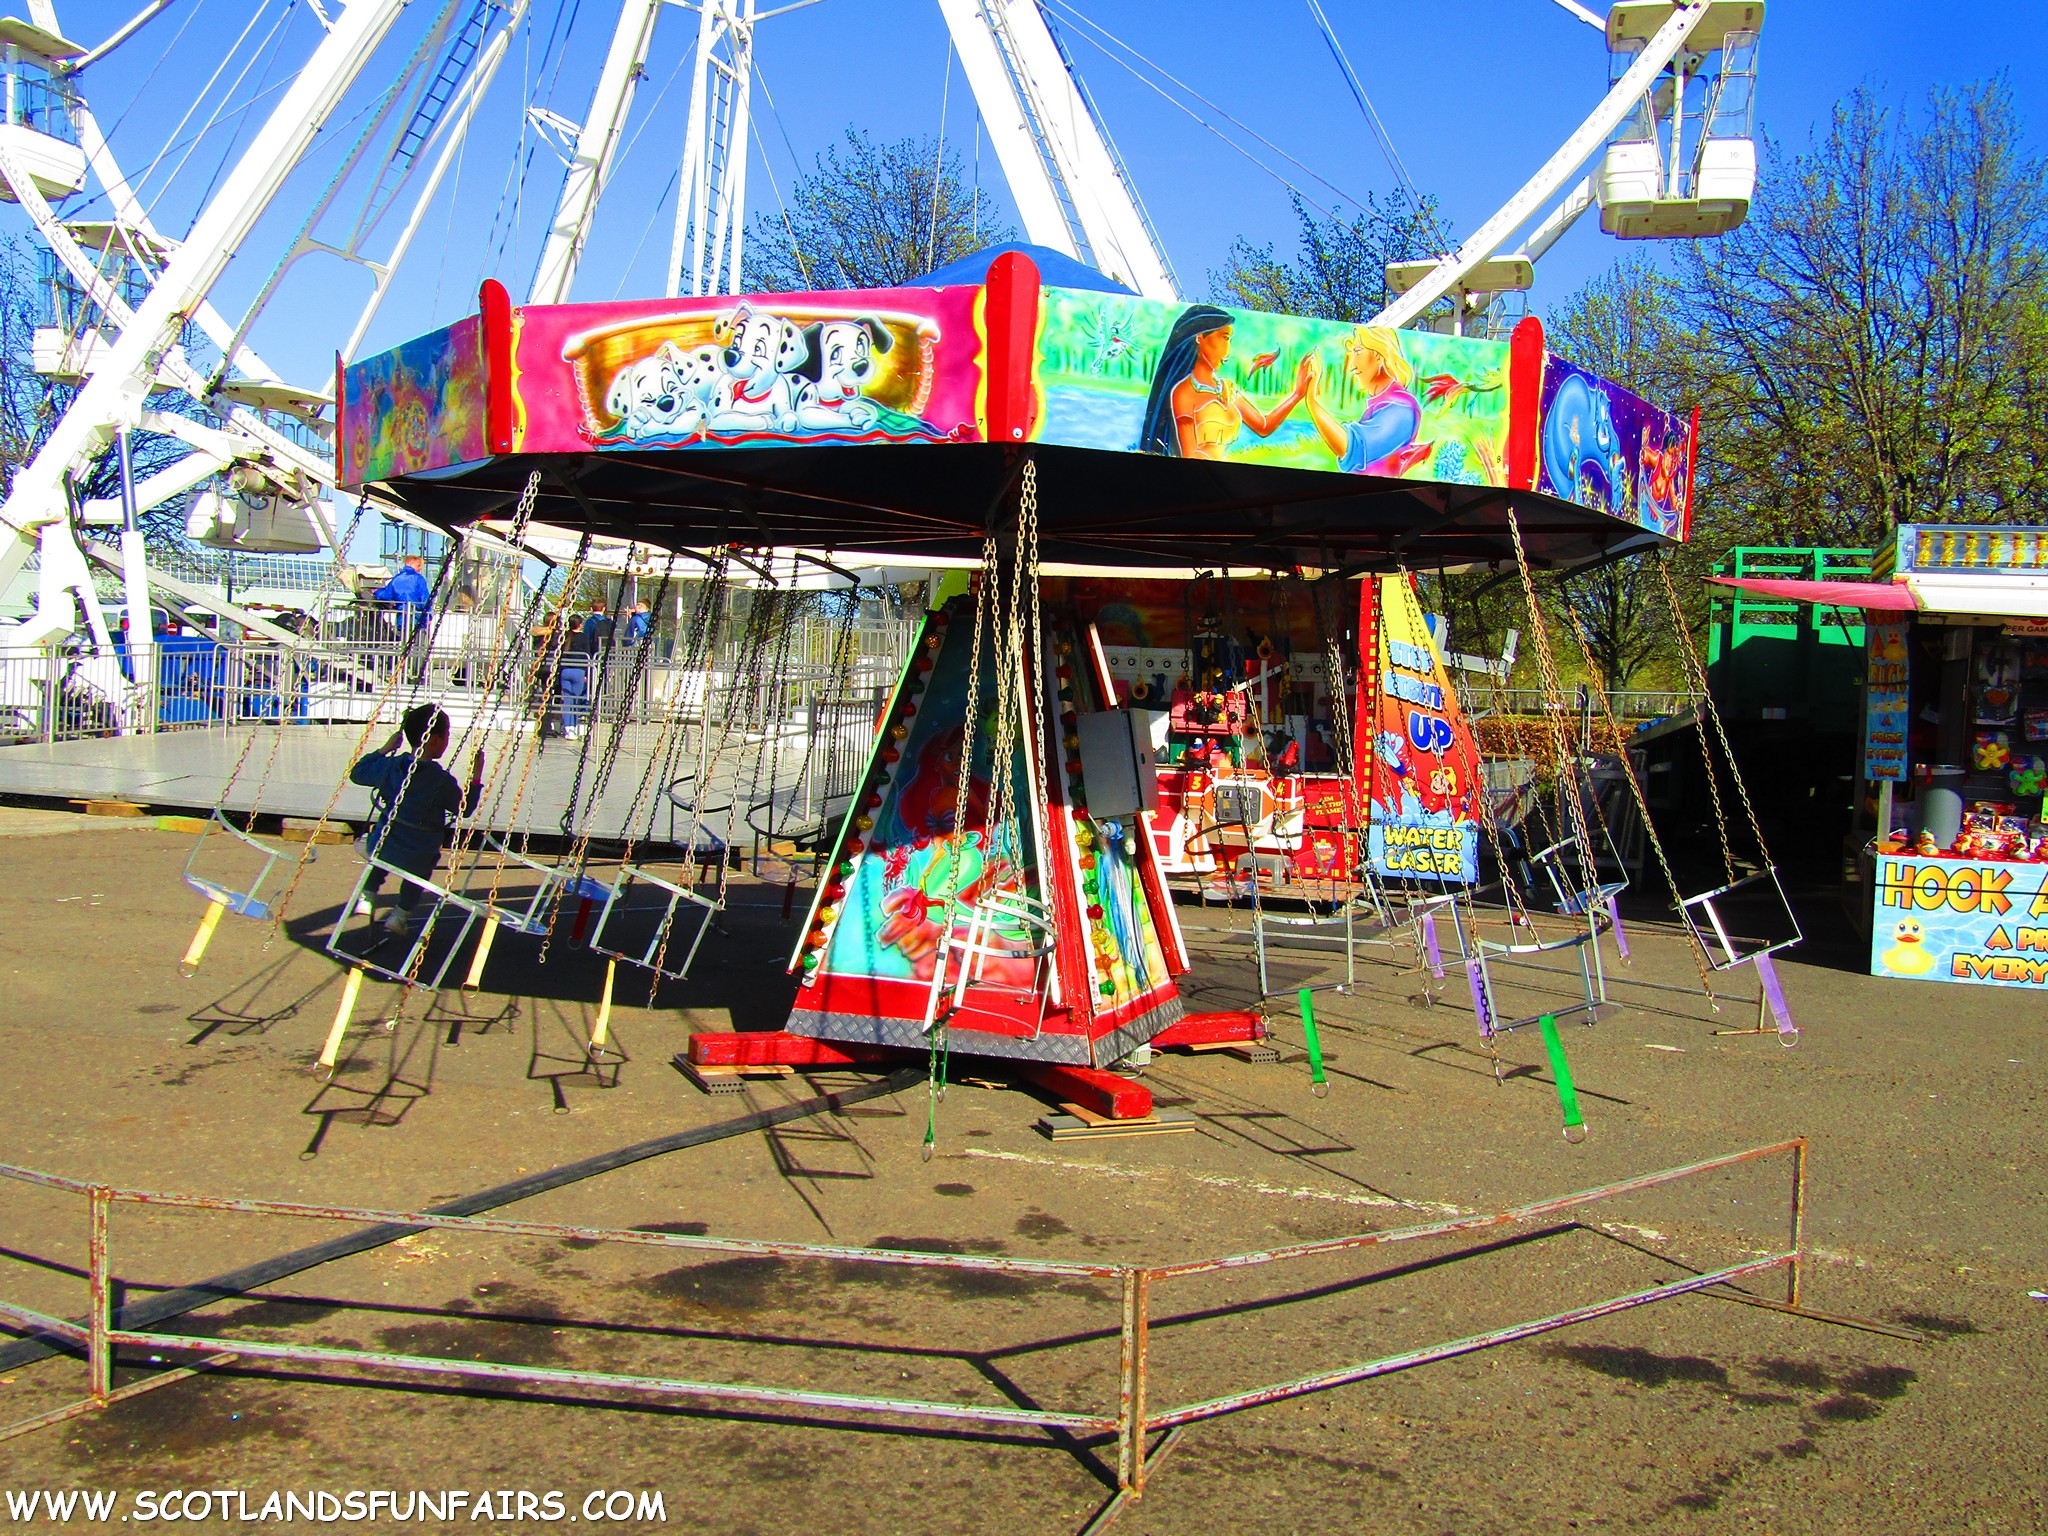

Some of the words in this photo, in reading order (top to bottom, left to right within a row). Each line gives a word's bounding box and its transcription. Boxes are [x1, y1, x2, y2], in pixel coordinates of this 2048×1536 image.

[1389, 640, 1434, 673] STEP
[1870, 628, 1885, 660] A
[1384, 670, 1445, 711] RIGHT
[1870, 664, 1907, 695] DUCK
[1409, 709, 1453, 756] UP
[1882, 714, 1892, 726] A
[1870, 732, 1903, 744] PRIZE
[1866, 748, 1905, 761] EVERY
[1191, 776, 1202, 790] 3
[1872, 765, 1900, 778] TIME
[1276, 781, 1284, 796] 4
[1384, 825, 1462, 850] WATER
[1385, 848, 1461, 875] LASER
[1883, 862, 2014, 916] HOOK
[1985, 924, 2013, 951] A
[1951, 952, 2048, 984] EVERY
